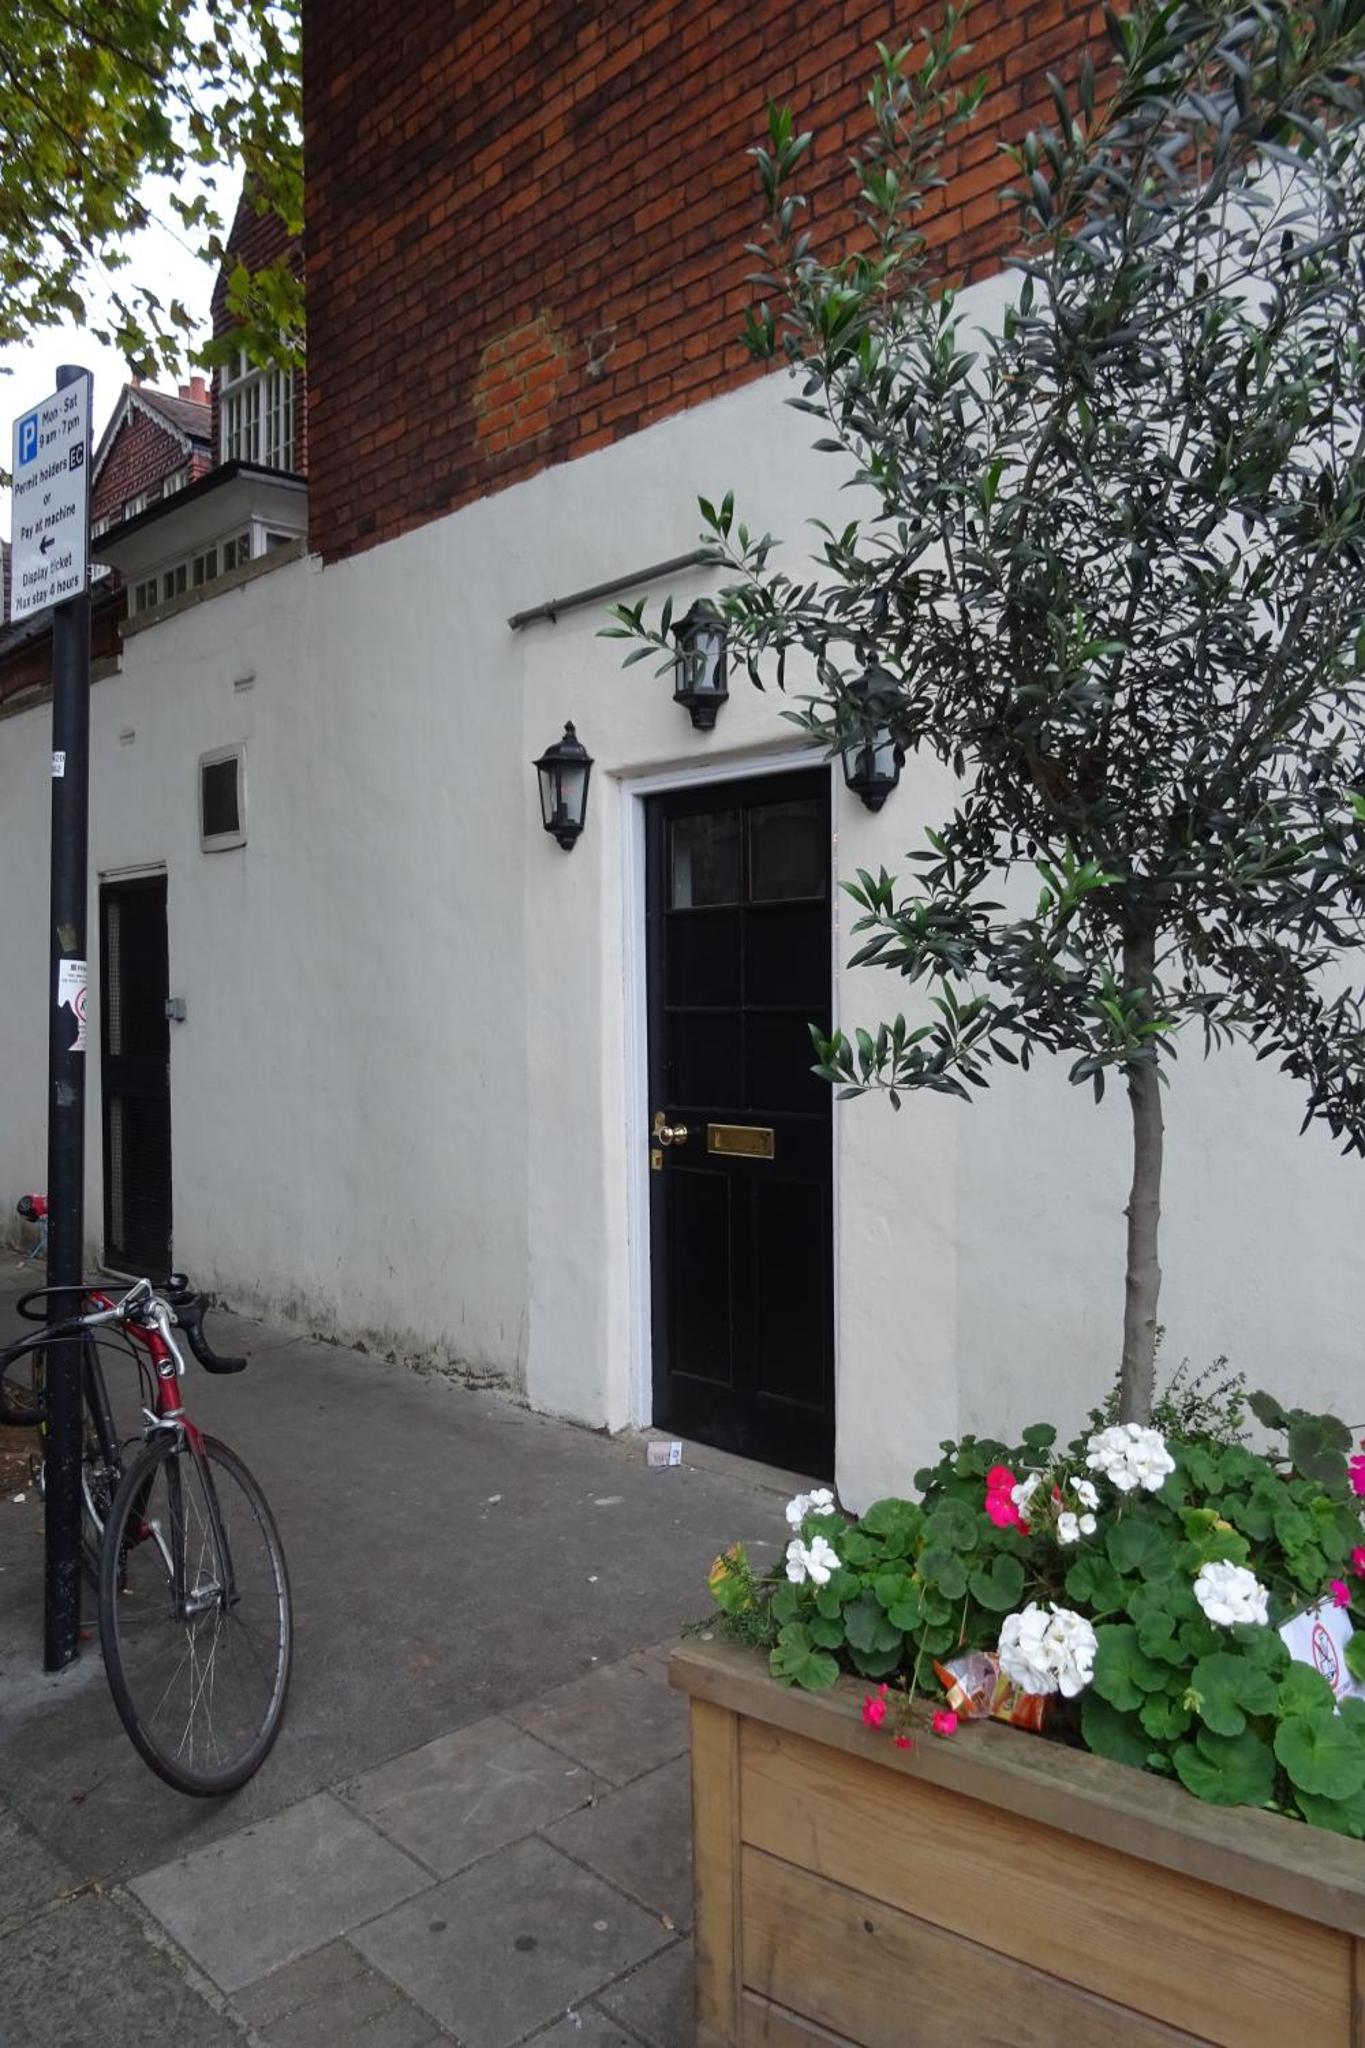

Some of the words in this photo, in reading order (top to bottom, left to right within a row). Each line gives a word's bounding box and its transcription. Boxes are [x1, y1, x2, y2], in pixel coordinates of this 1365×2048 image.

[42, 408, 58, 427] Mon
[64, 393, 77, 413] Sat
[23, 421, 35, 461] P
[14, 473, 38, 496] Permit
[40, 458, 68, 483] holders
[43, 493, 52, 506] or
[21, 526, 33, 541] Pay
[35, 520, 43, 533] at
[44, 503, 76, 527] machine
[22, 565, 49, 587] Display
[50, 552, 72, 573] ticket
[16, 596, 31, 612] Max
[32, 588, 48, 605] stay
[56, 575, 79, 593] hours
